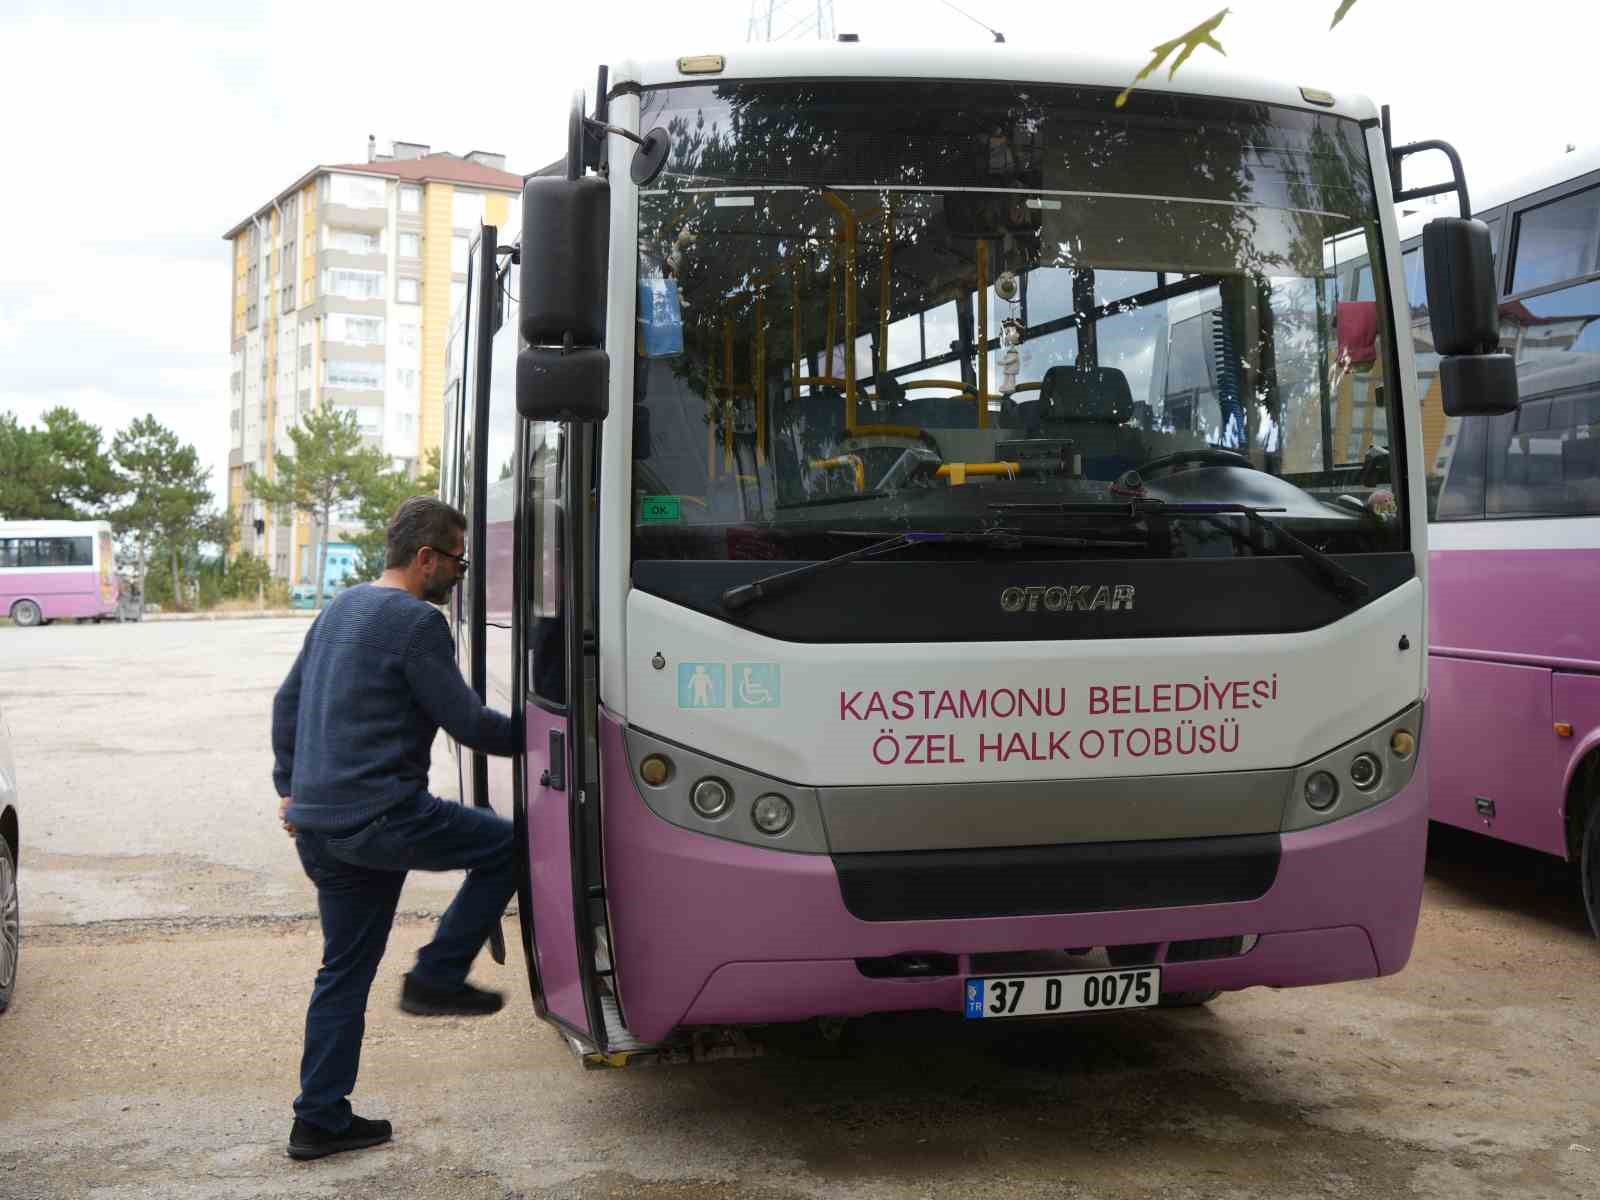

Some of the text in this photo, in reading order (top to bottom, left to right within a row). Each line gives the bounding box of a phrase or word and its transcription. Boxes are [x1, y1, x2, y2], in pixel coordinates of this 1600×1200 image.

[1001, 585, 1136, 611] OTOKAR
[840, 673, 1278, 720] KASTAMONU BELEDİYESİ
[872, 718, 1239, 765] ÖZEL HALK OTOBÜSÜ
[968, 1002, 983, 1011] TR
[990, 972, 1152, 1013] 37 D 0075
